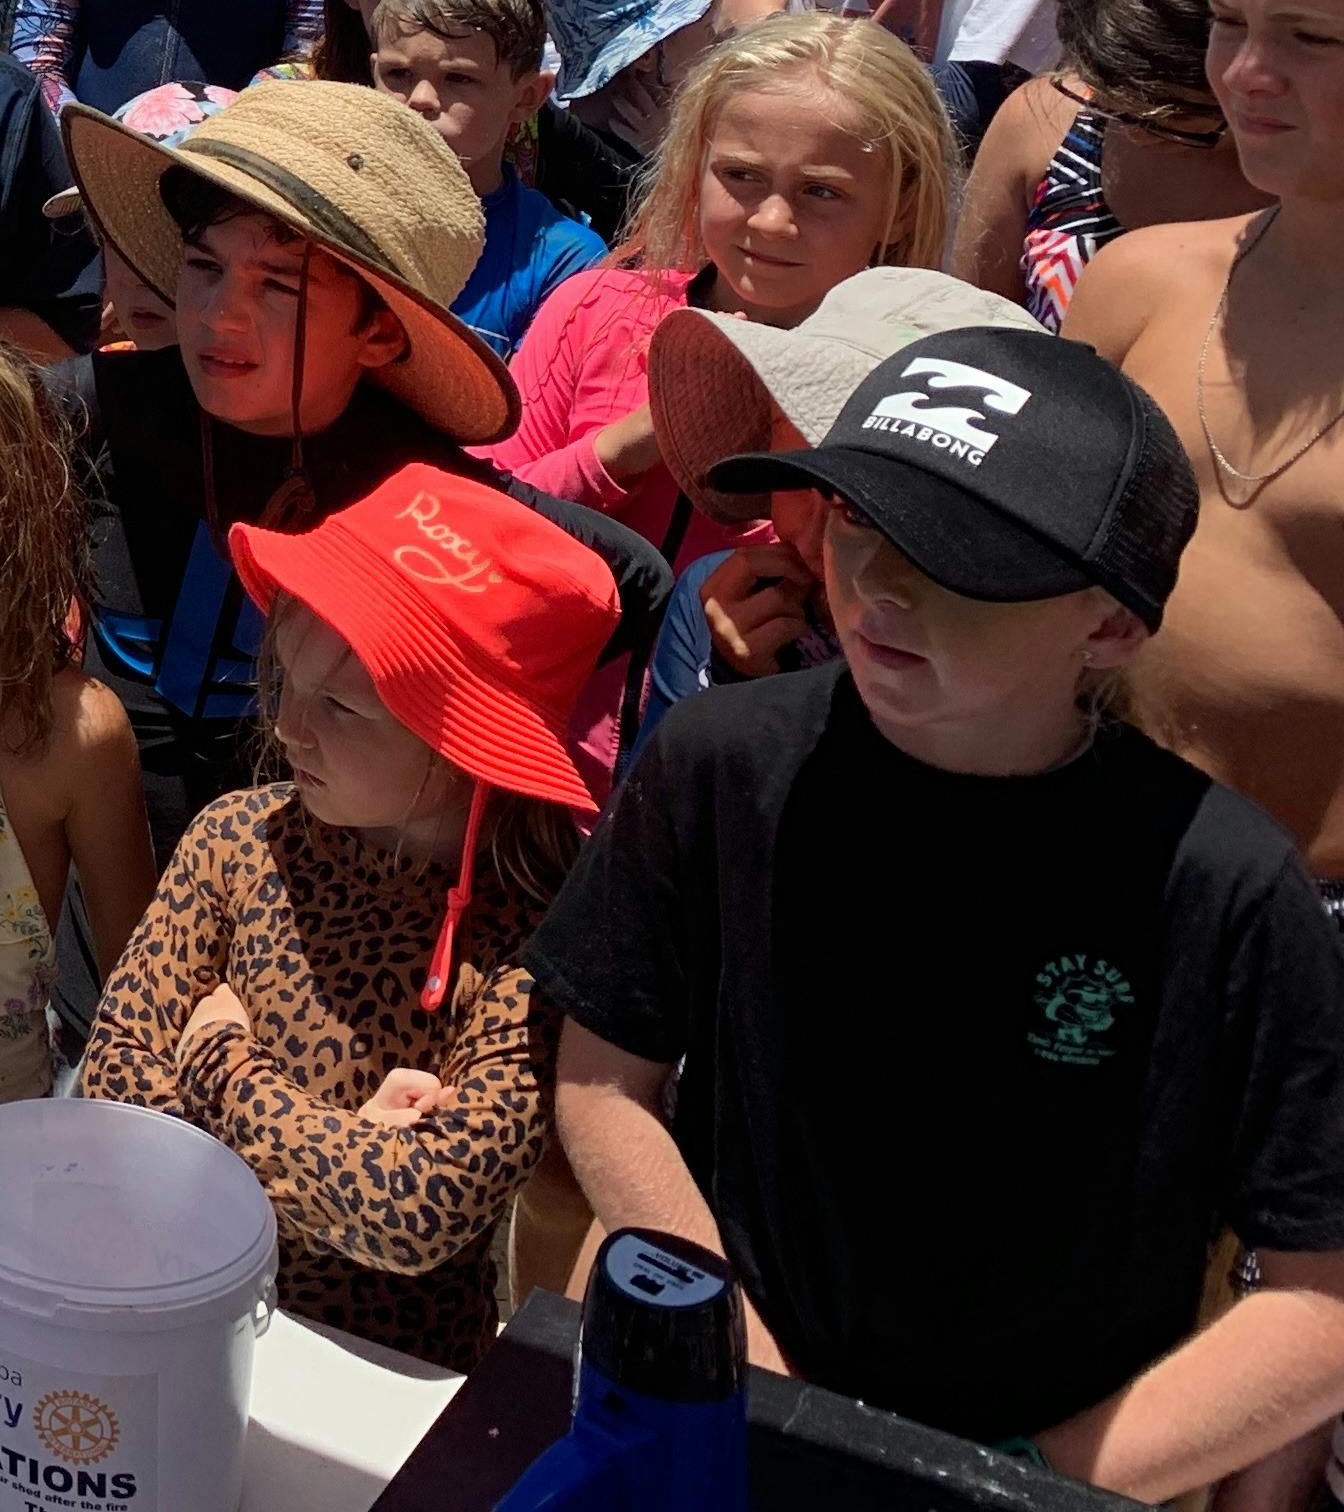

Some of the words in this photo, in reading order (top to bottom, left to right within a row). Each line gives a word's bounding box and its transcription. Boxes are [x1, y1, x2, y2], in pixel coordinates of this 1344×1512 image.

[862, 415, 987, 467] BILLABONG
[393, 489, 492, 593] Roxy
[1036, 954, 1088, 987] STAY
[12, 1480, 41, 1499] shed
[44, 1492, 78, 1508] after
[79, 1498, 103, 1511] the
[105, 1501, 129, 1512] fire
